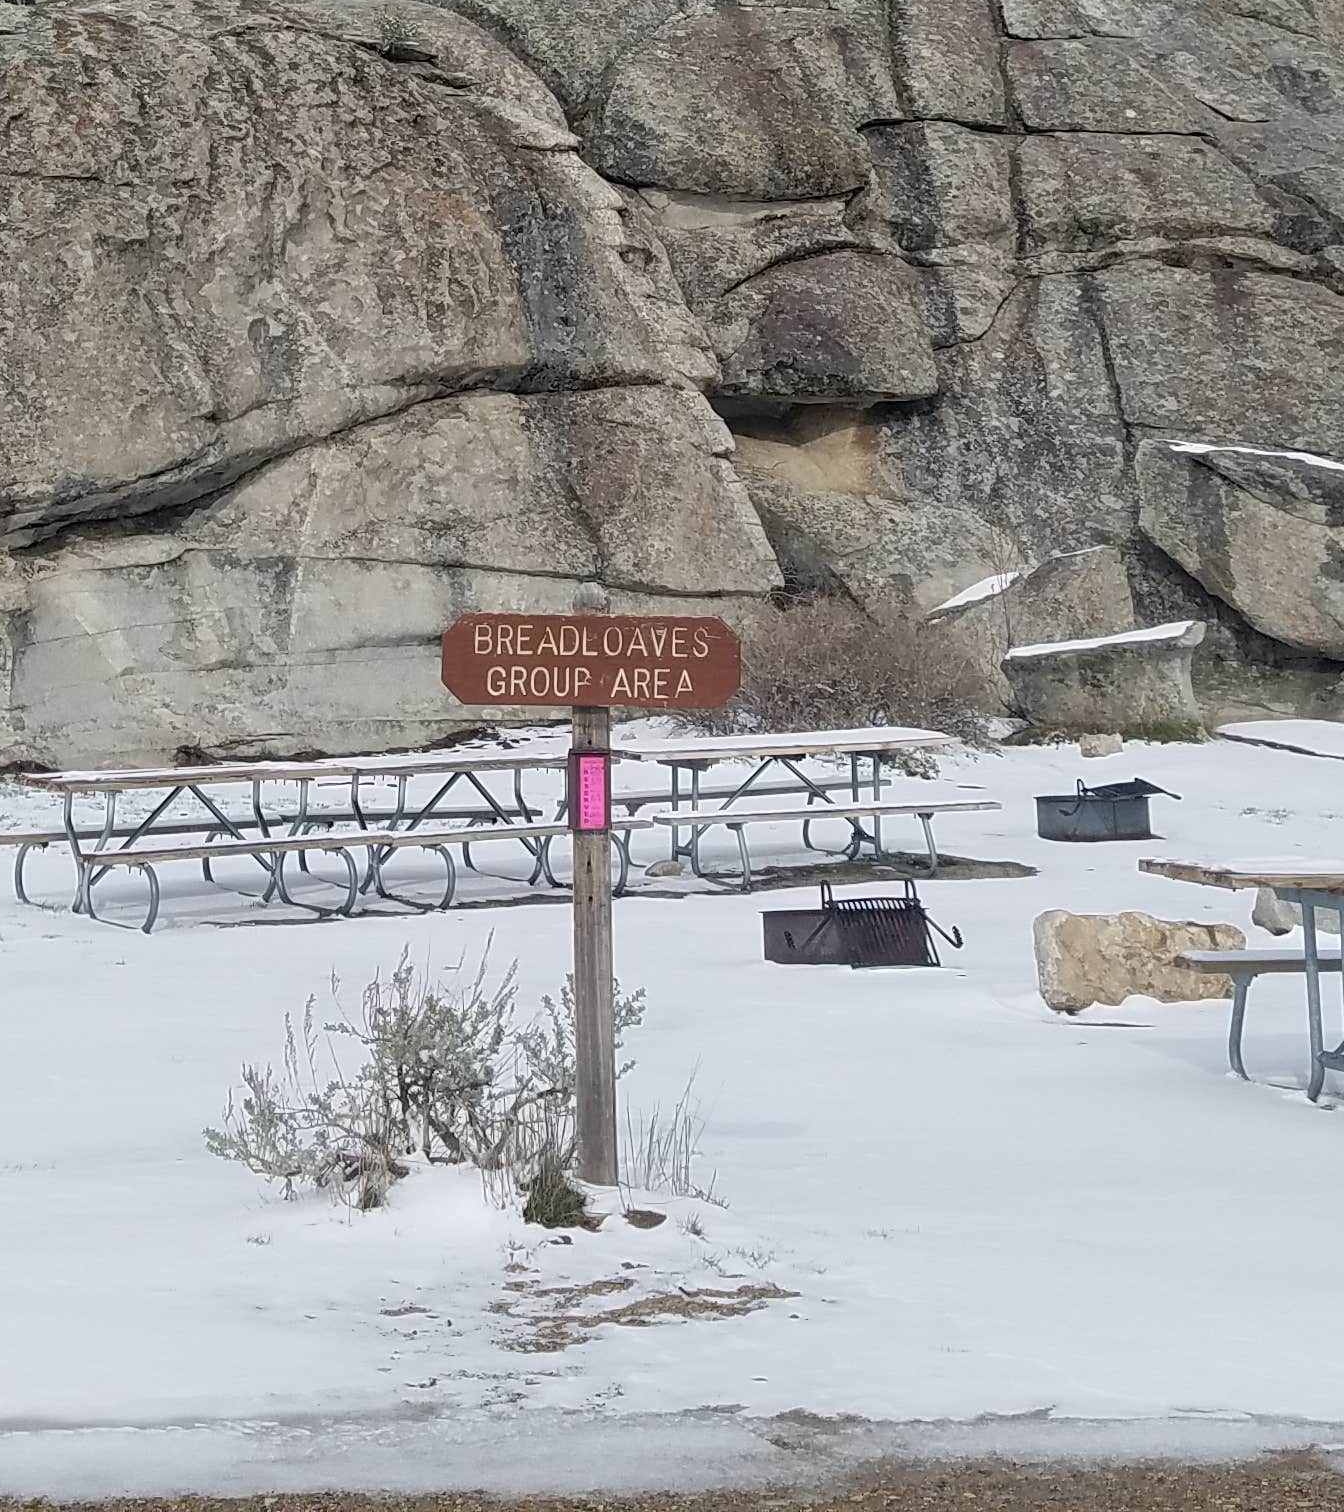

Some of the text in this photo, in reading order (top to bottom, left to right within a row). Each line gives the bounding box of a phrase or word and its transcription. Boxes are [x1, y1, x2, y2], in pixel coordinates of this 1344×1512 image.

[474, 624, 709, 658] BREADLOAVES
[486, 666, 693, 699] GROUP AREA
